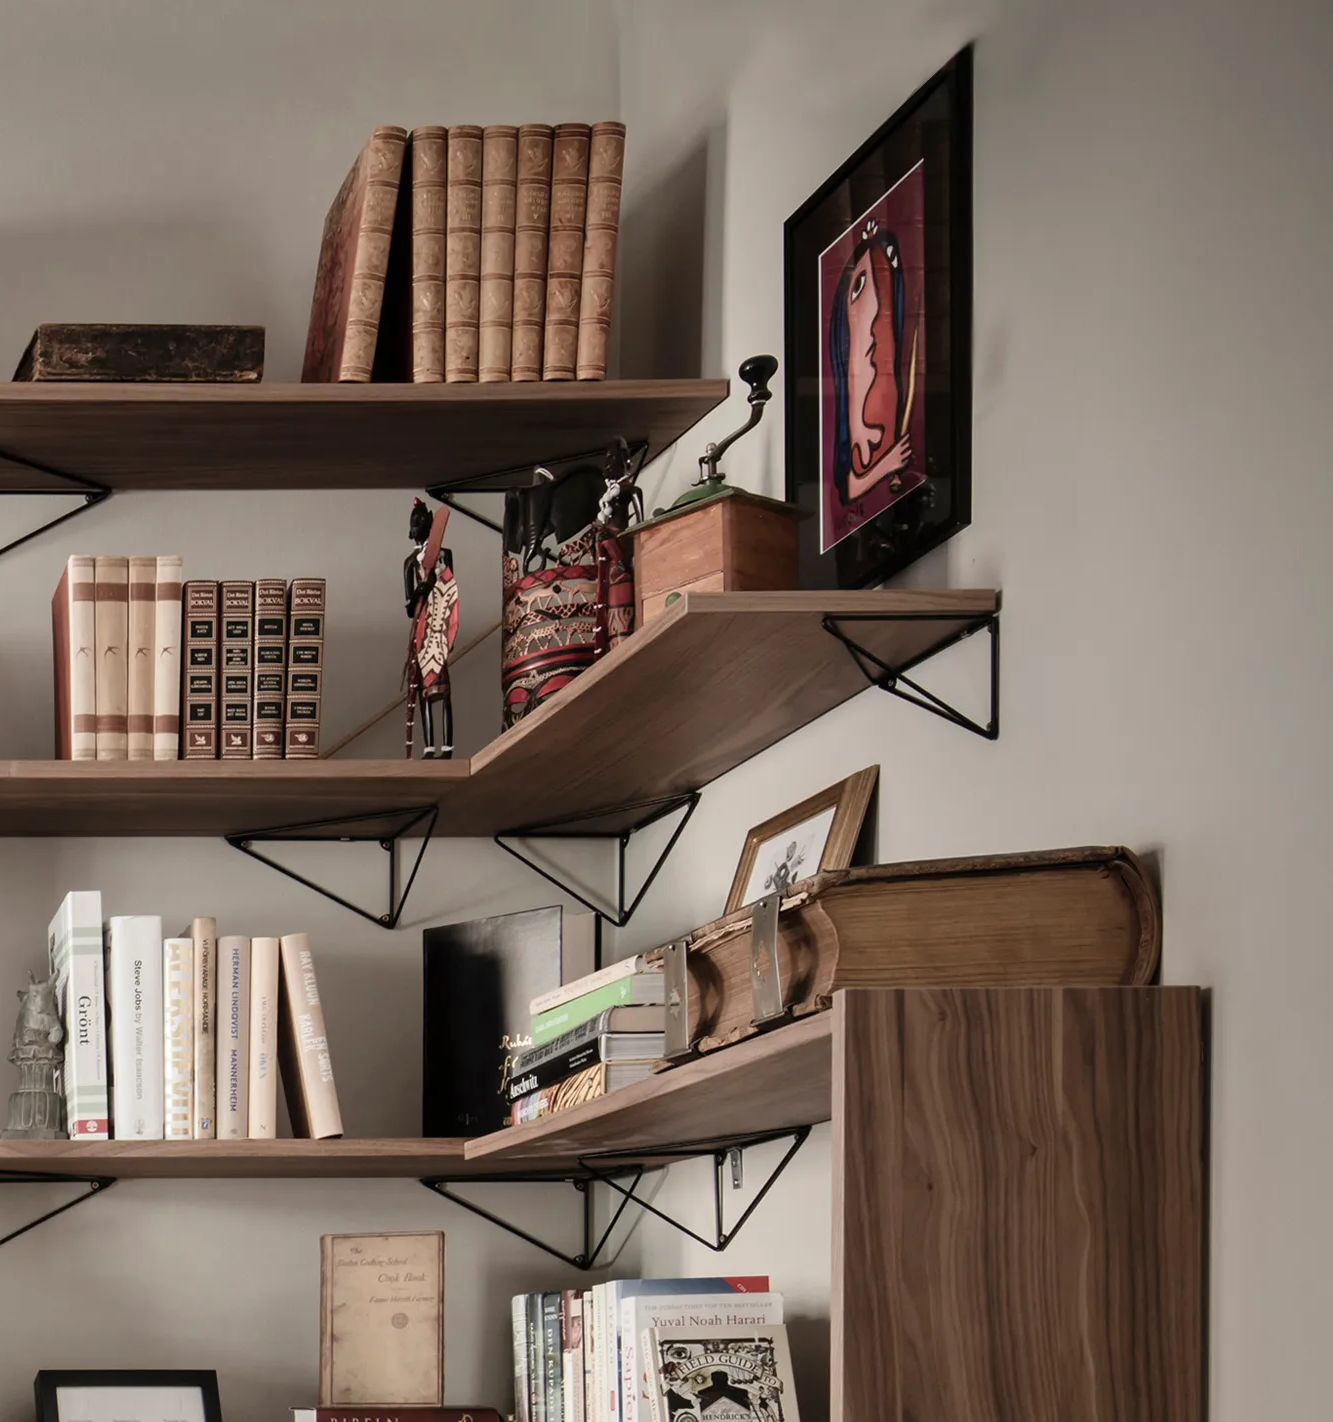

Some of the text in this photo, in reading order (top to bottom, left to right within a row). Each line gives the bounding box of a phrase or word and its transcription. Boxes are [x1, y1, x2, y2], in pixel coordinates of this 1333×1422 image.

[134, 960, 143, 986] Steve
[299, 950, 319, 1006] RAY KLUUN
[134, 988, 143, 1011] Jobs
[77, 995, 93, 1046] Grönt
[133, 1012, 144, 1025] by
[229, 948, 240, 1112] HERMAN LINDQVIST MANNERHEIM
[509, 1074, 539, 1100] Auschwitz
[651, 1314, 767, 1328] Yuval Noah Harari
[678, 1355, 777, 1386] FIELD GUIDE TO
[547, 1360, 555, 1412] KUPADE
[703, 1412, 751, 1421] HENDRICK'S
